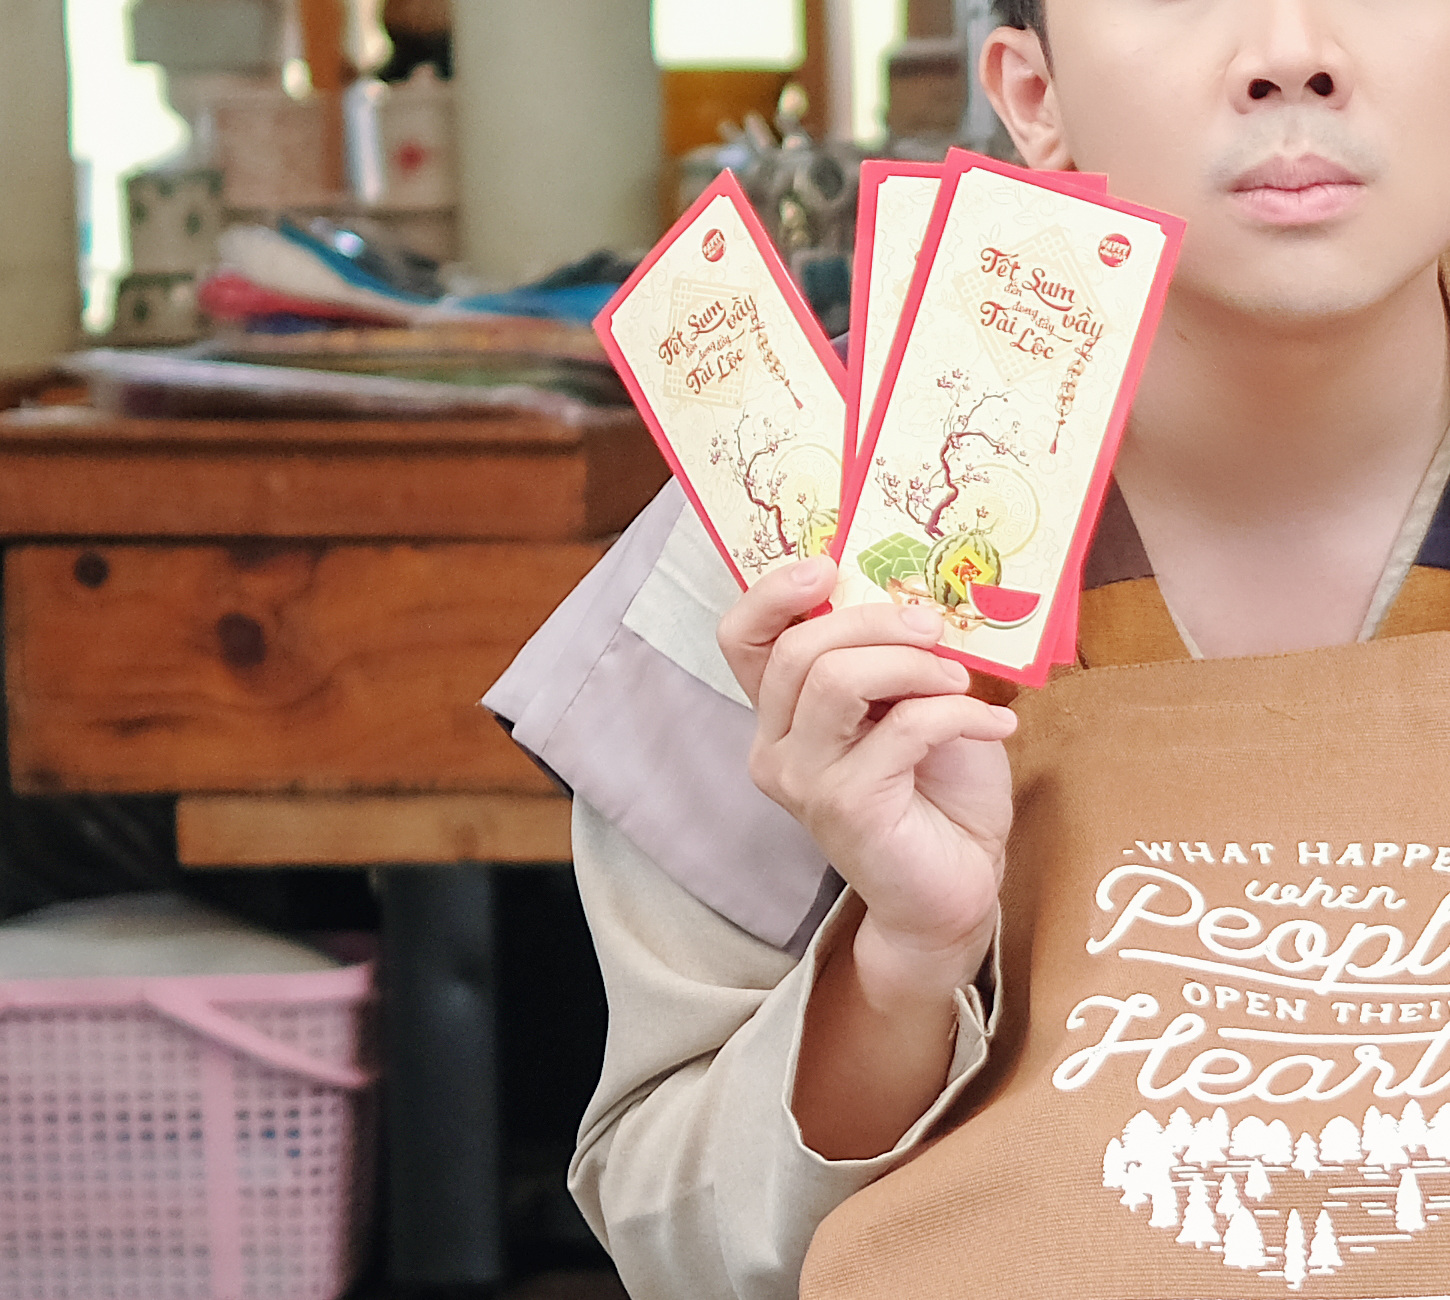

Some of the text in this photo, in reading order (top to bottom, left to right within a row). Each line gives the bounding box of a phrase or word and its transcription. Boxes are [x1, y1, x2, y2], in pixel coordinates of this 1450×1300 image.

[980, 247, 1021, 281] Tết
[687, 300, 726, 342] Sum
[1021, 267, 1104, 341] Sum vầy
[659, 326, 687, 365] Tết
[980, 301, 1054, 360] Tài Lộc
[1244, 877, 1406, 912] when
[1182, 981, 1308, 1020] OPEN
